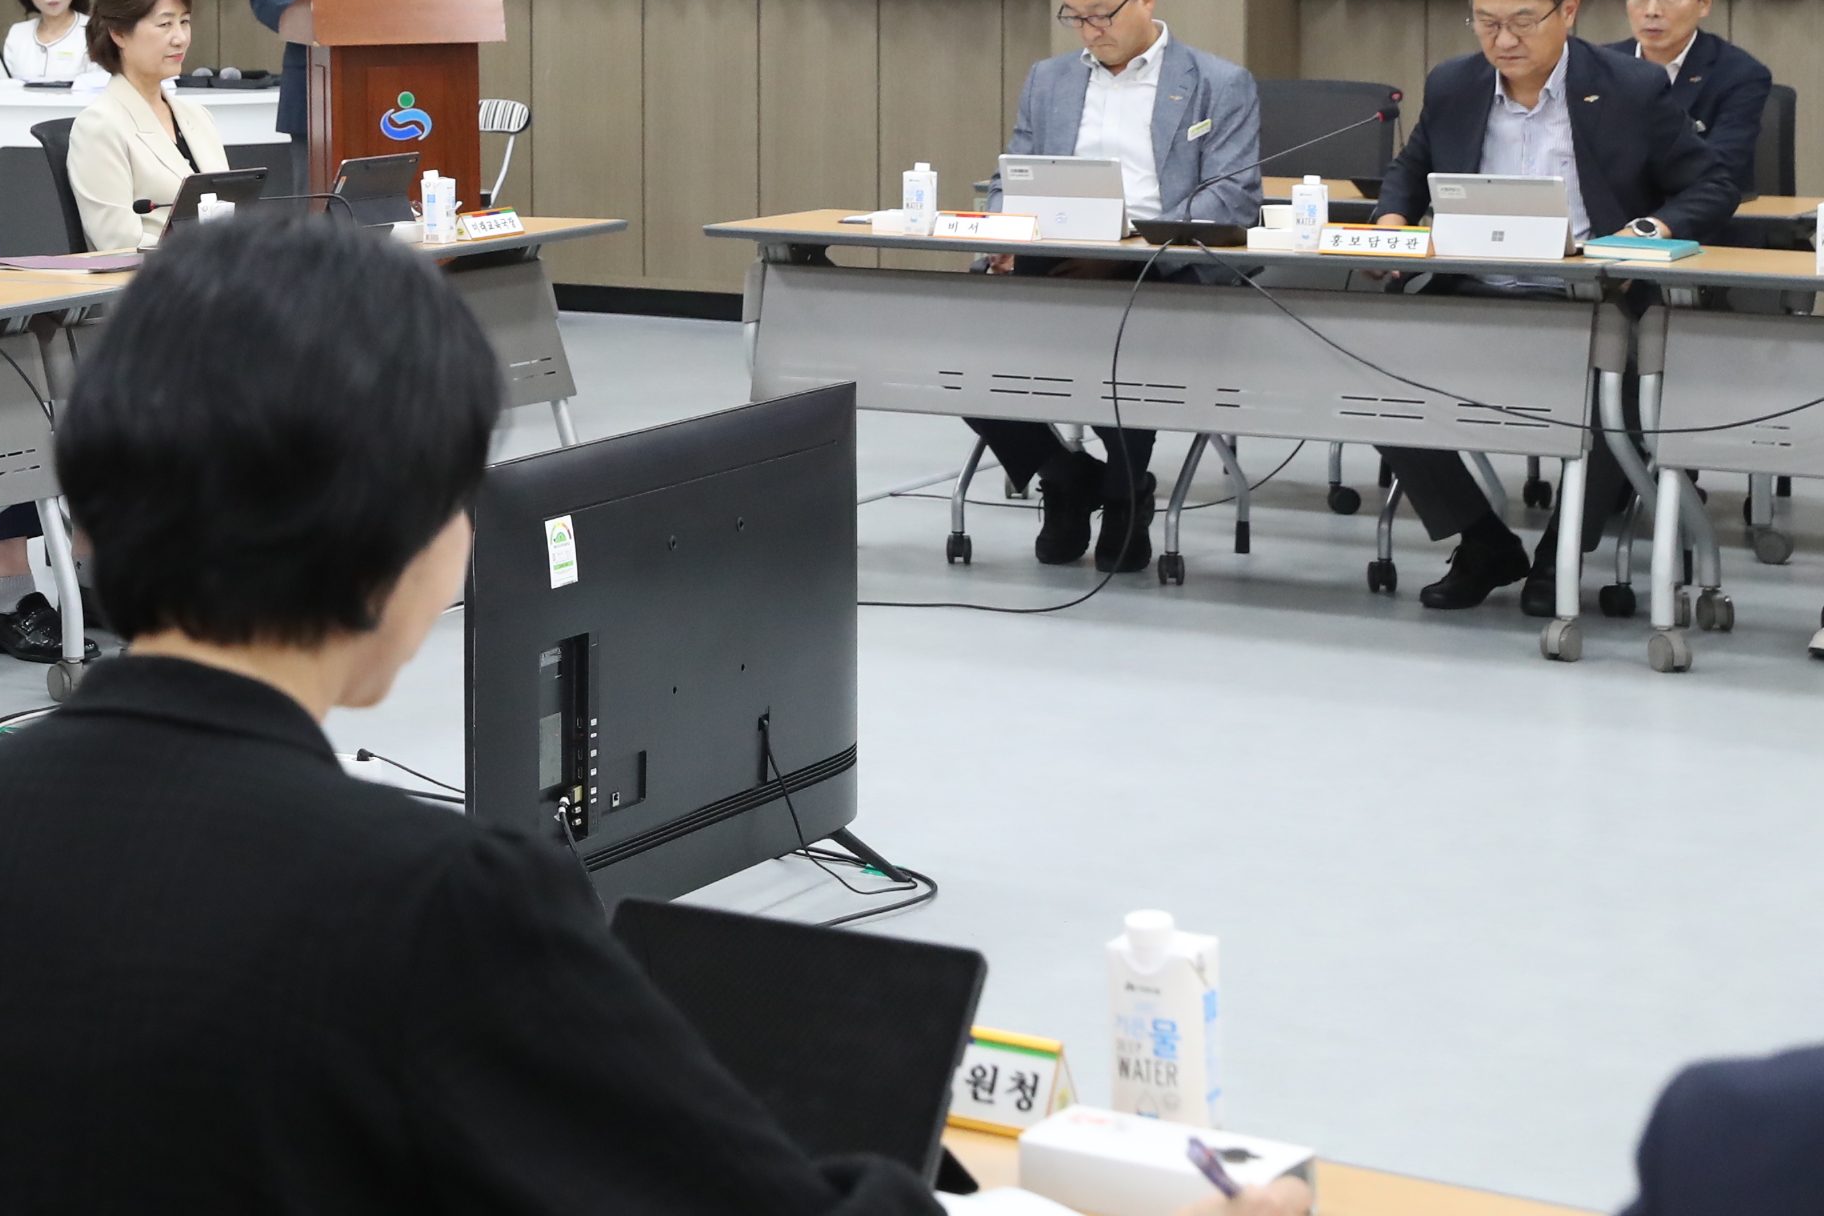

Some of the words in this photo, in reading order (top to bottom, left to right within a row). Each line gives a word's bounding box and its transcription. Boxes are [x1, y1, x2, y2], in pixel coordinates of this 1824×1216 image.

[1150, 1017, 1180, 1059] 물
[965, 1063, 1040, 1112] 원청
[1118, 1056, 1178, 1087] WATER
